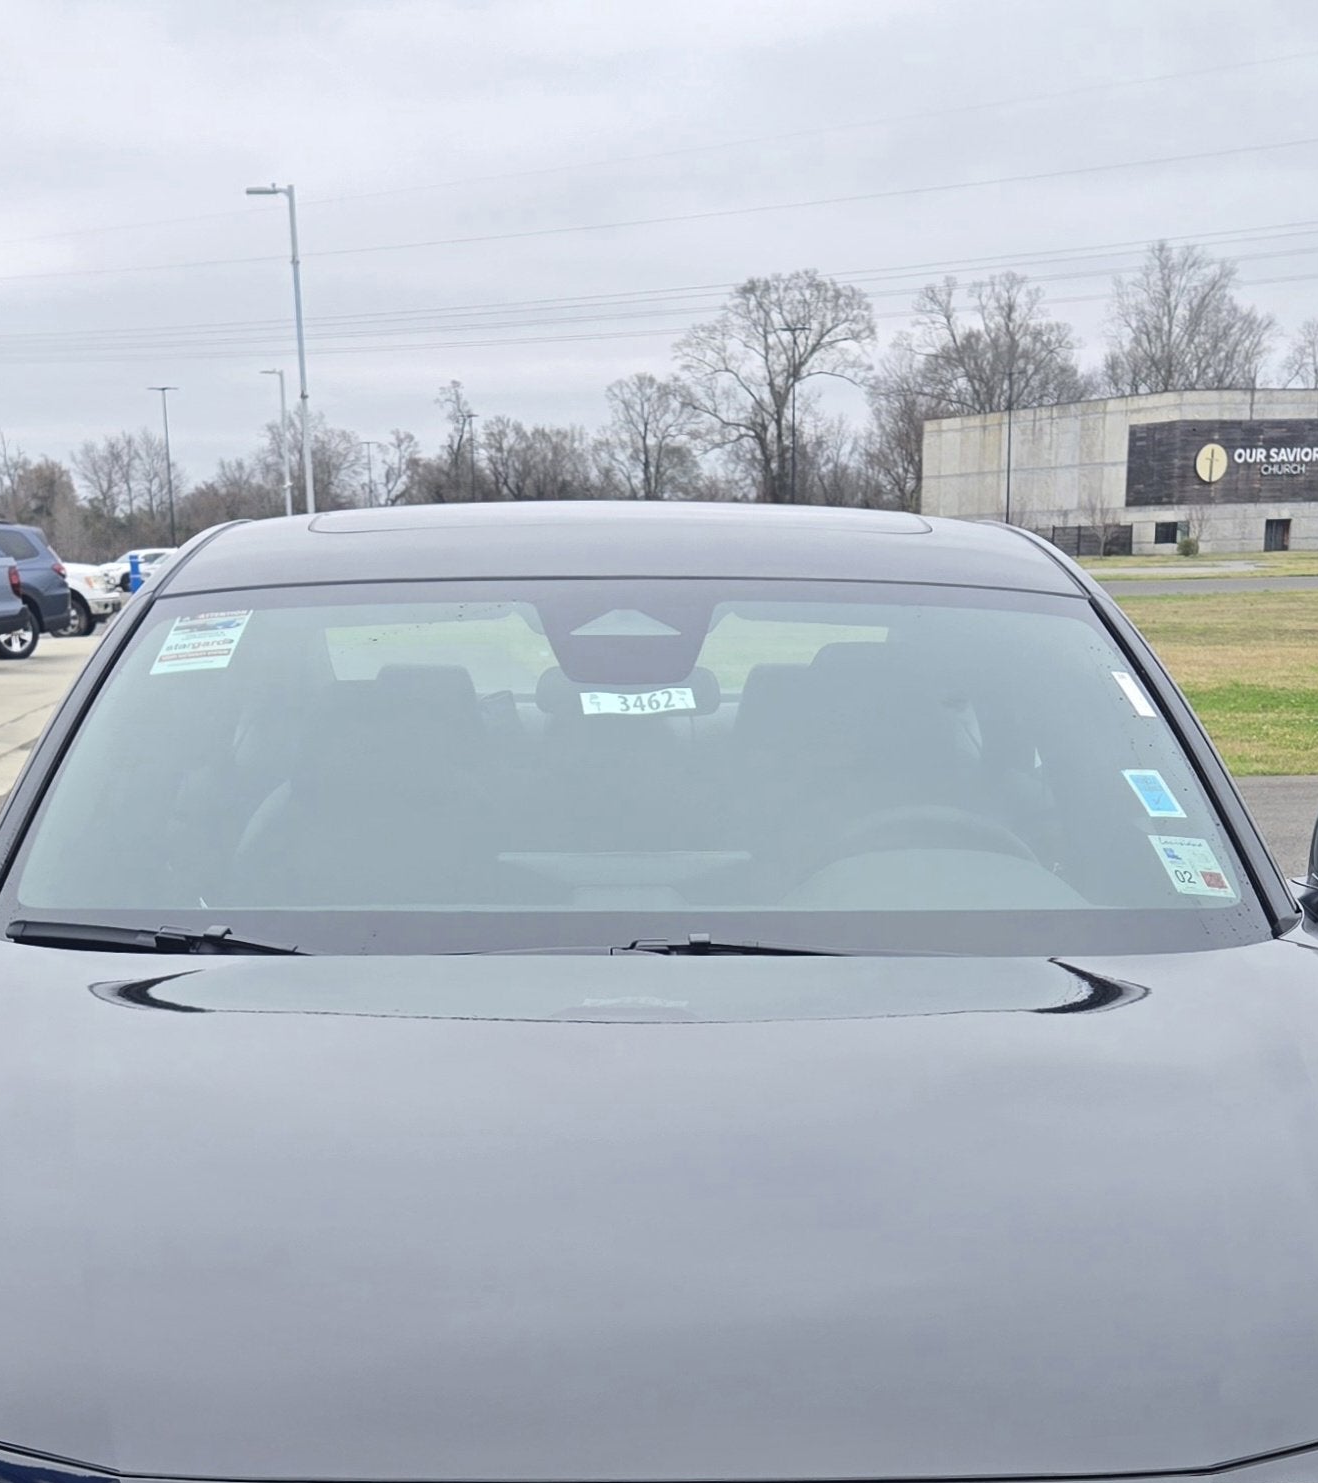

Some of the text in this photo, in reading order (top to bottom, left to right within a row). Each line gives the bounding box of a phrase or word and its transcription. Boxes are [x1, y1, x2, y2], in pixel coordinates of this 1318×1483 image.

[1234, 448, 1267, 463] OUR
[1261, 463, 1306, 475] CHURCH
[617, 690, 676, 712] 3462
[1174, 869, 1197, 885] 02
